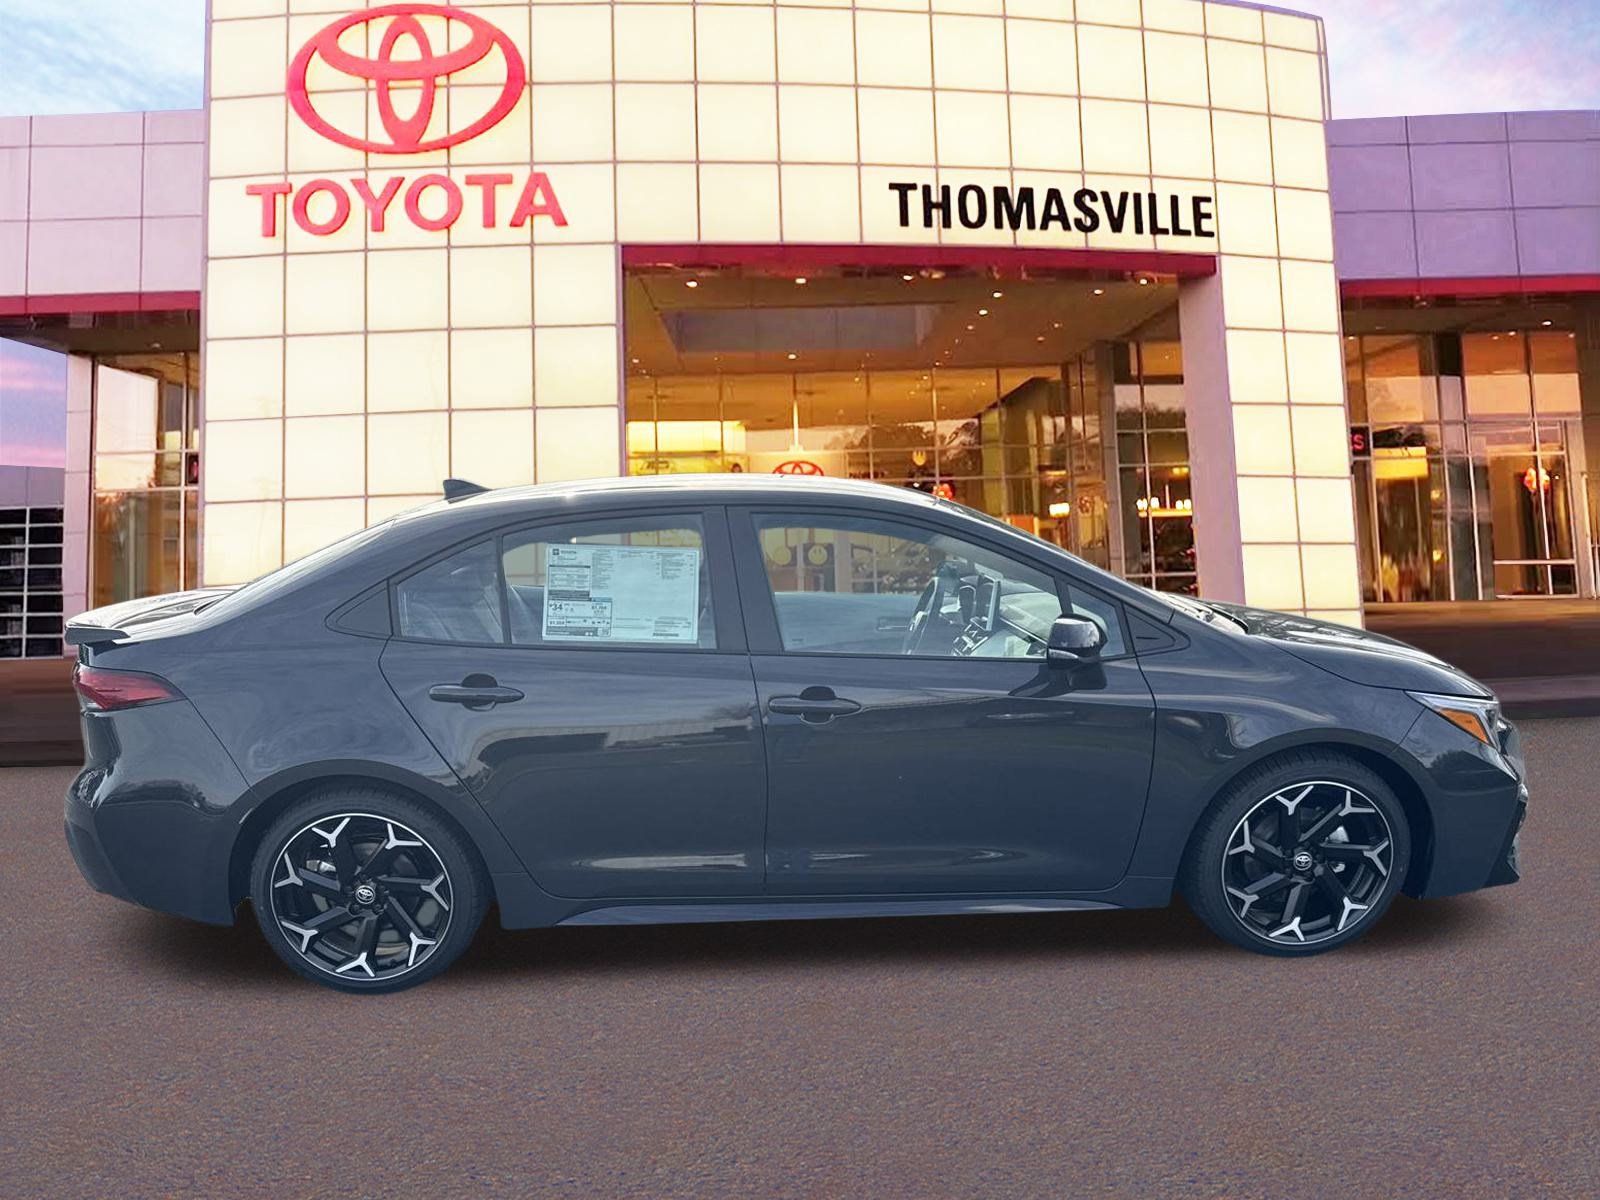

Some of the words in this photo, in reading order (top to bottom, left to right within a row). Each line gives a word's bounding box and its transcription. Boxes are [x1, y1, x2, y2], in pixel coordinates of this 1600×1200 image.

[246, 172, 568, 237] TOYOTA
[888, 182, 1215, 238] THOMASVILLE
[1351, 434, 1364, 450] S
